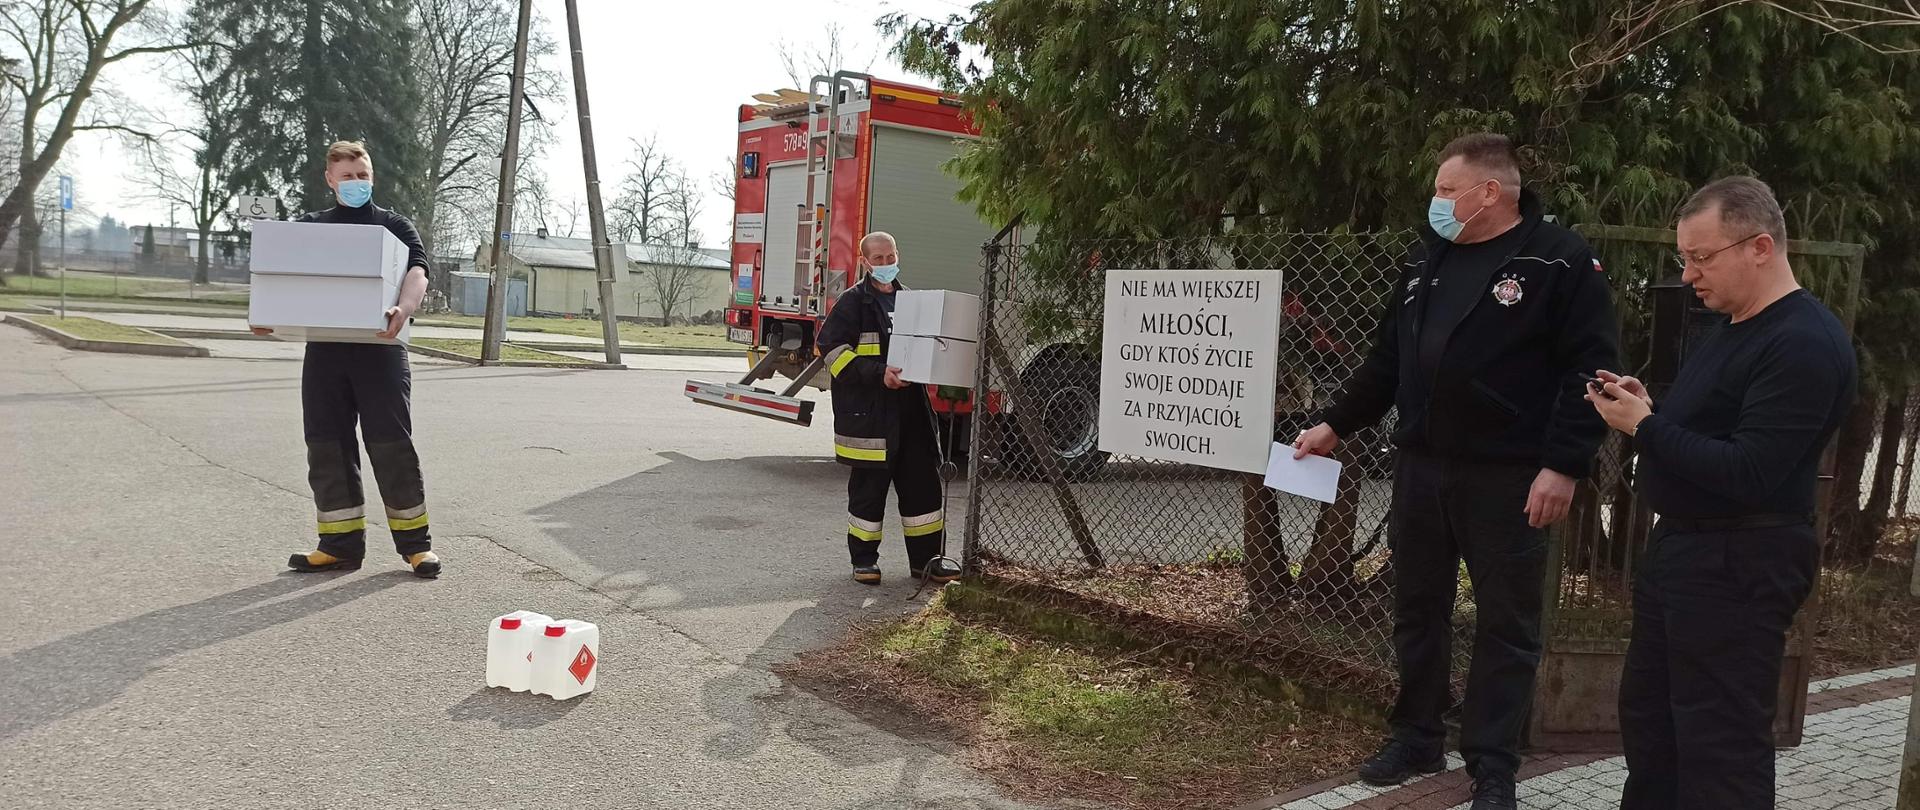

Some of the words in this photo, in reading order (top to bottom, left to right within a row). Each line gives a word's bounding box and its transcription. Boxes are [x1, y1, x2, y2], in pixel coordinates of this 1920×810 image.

[63, 178, 71, 208] P
[1121, 280, 1148, 297] NIE
[1152, 280, 1177, 298] MA
[1182, 280, 1260, 303] WIĘKSZEJ
[1139, 307, 1233, 340] MIŁOŚCI,
[1120, 344, 1153, 362] GDY
[1158, 343, 1200, 365] KTOŚ
[1204, 344, 1254, 368] ŻYCIE
[1124, 371, 1173, 395] SWOJE
[1178, 376, 1245, 402] ODDAJE
[1123, 399, 1142, 417] ZA
[1147, 402, 1243, 429] PRZYJACIÓŁ
[1144, 430, 1216, 455] SWOICH.
